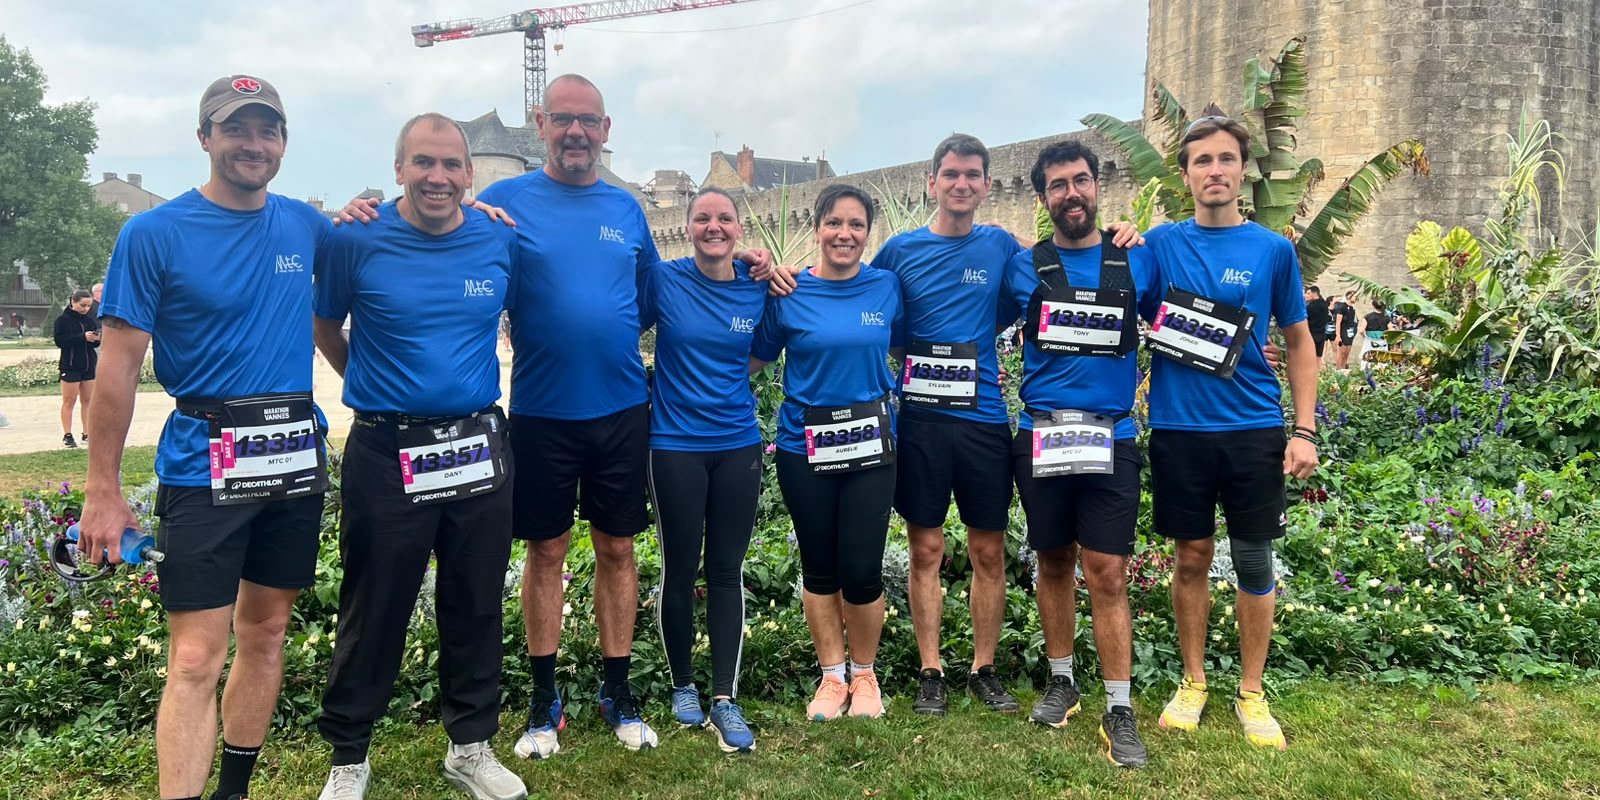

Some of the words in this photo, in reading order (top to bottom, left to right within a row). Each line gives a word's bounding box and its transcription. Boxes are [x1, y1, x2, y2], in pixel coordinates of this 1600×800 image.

[1050, 309, 1118, 330] 13358
[1163, 312, 1228, 343] 13358
[1049, 344, 1079, 352] DECATHLON
[911, 362, 971, 381] 13358
[236, 428, 311, 457] 13357
[814, 424, 874, 448] 13358
[1041, 430, 1106, 450] 13358
[411, 442, 484, 472] 13357
[242, 479, 282, 489] DECATHLON
[421, 490, 457, 500] DECATHLON
